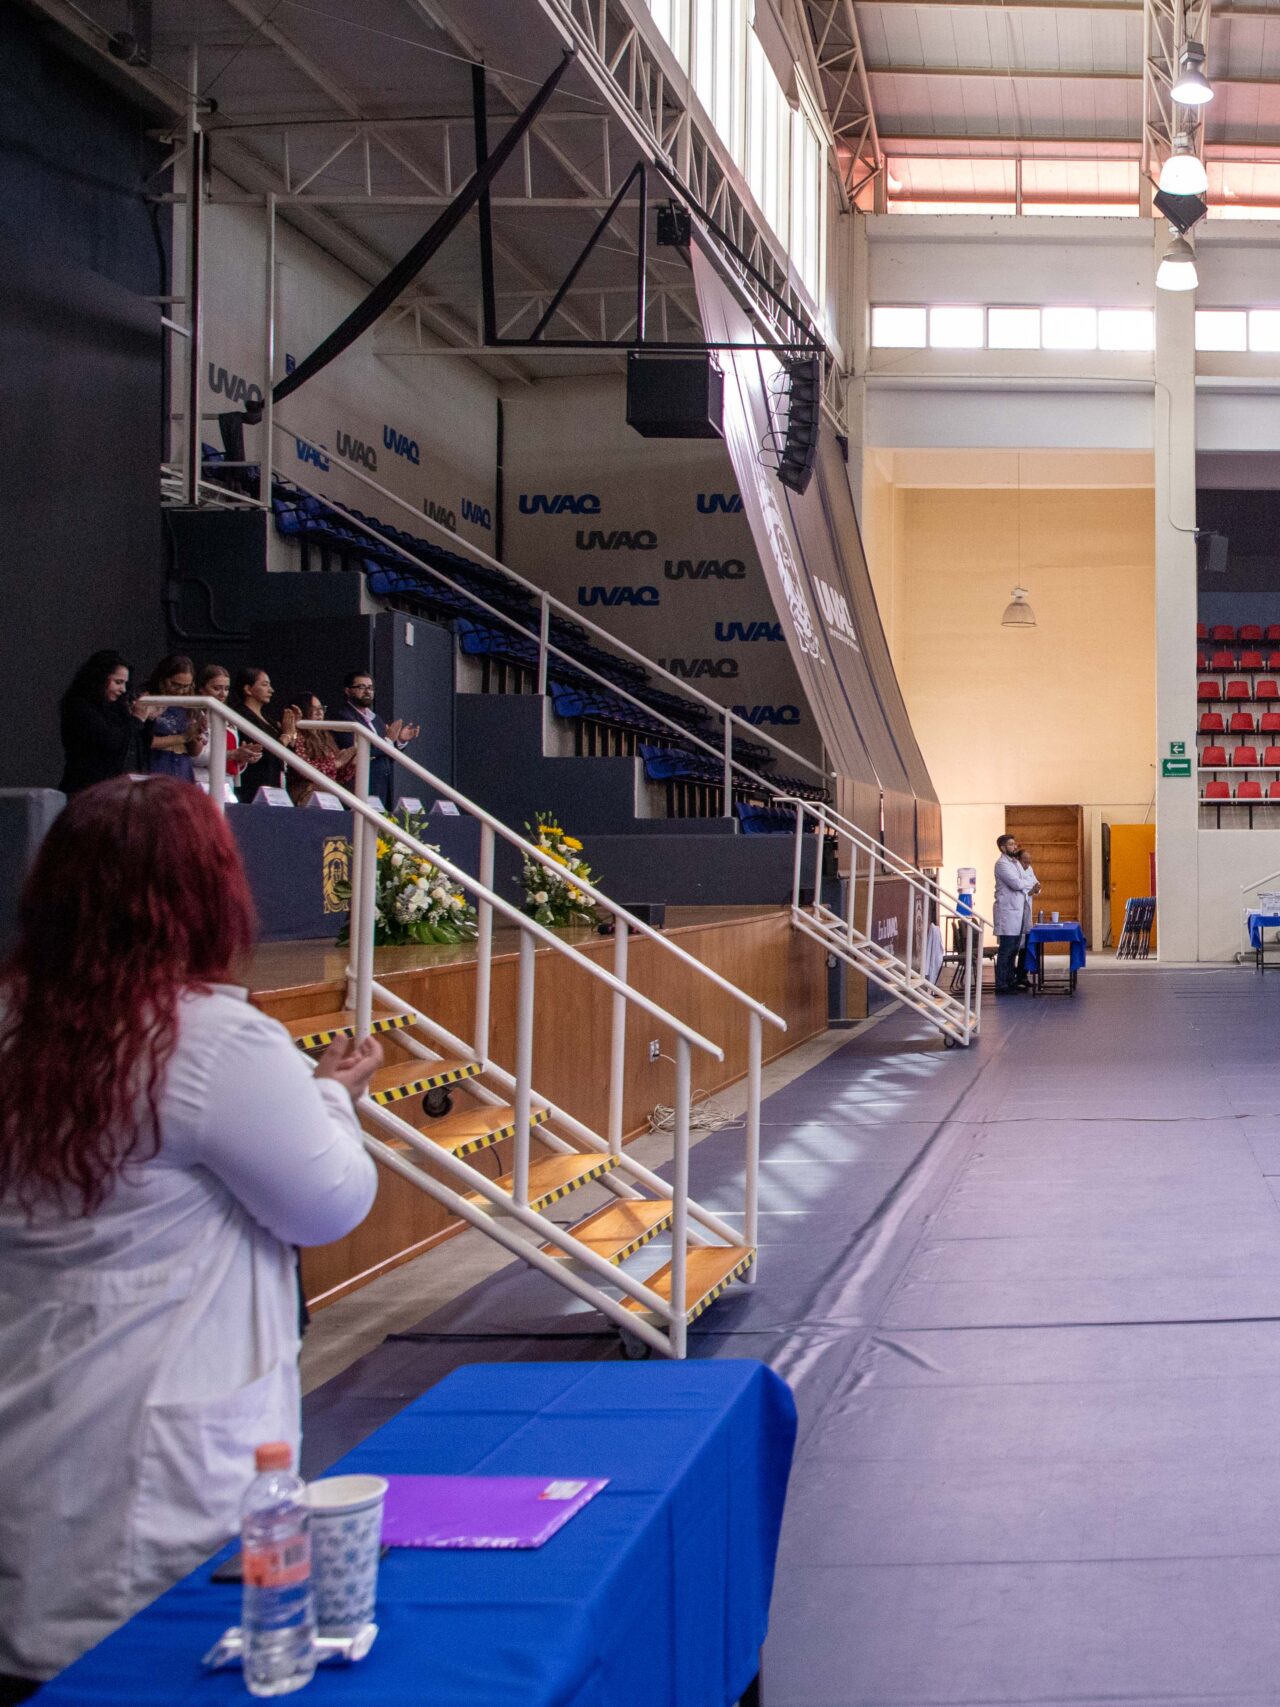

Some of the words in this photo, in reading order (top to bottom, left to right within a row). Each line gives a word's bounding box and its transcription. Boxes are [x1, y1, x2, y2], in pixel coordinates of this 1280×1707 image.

[296, 437, 330, 472] VAQ
[337, 430, 378, 472] UVAQ
[383, 424, 420, 465] UVAQ
[461, 497, 492, 530] UVAQ
[519, 494, 601, 514] UVAQ
[575, 530, 658, 550] UVAQ
[663, 560, 747, 580] UVAQ
[577, 586, 660, 606] UVAQ
